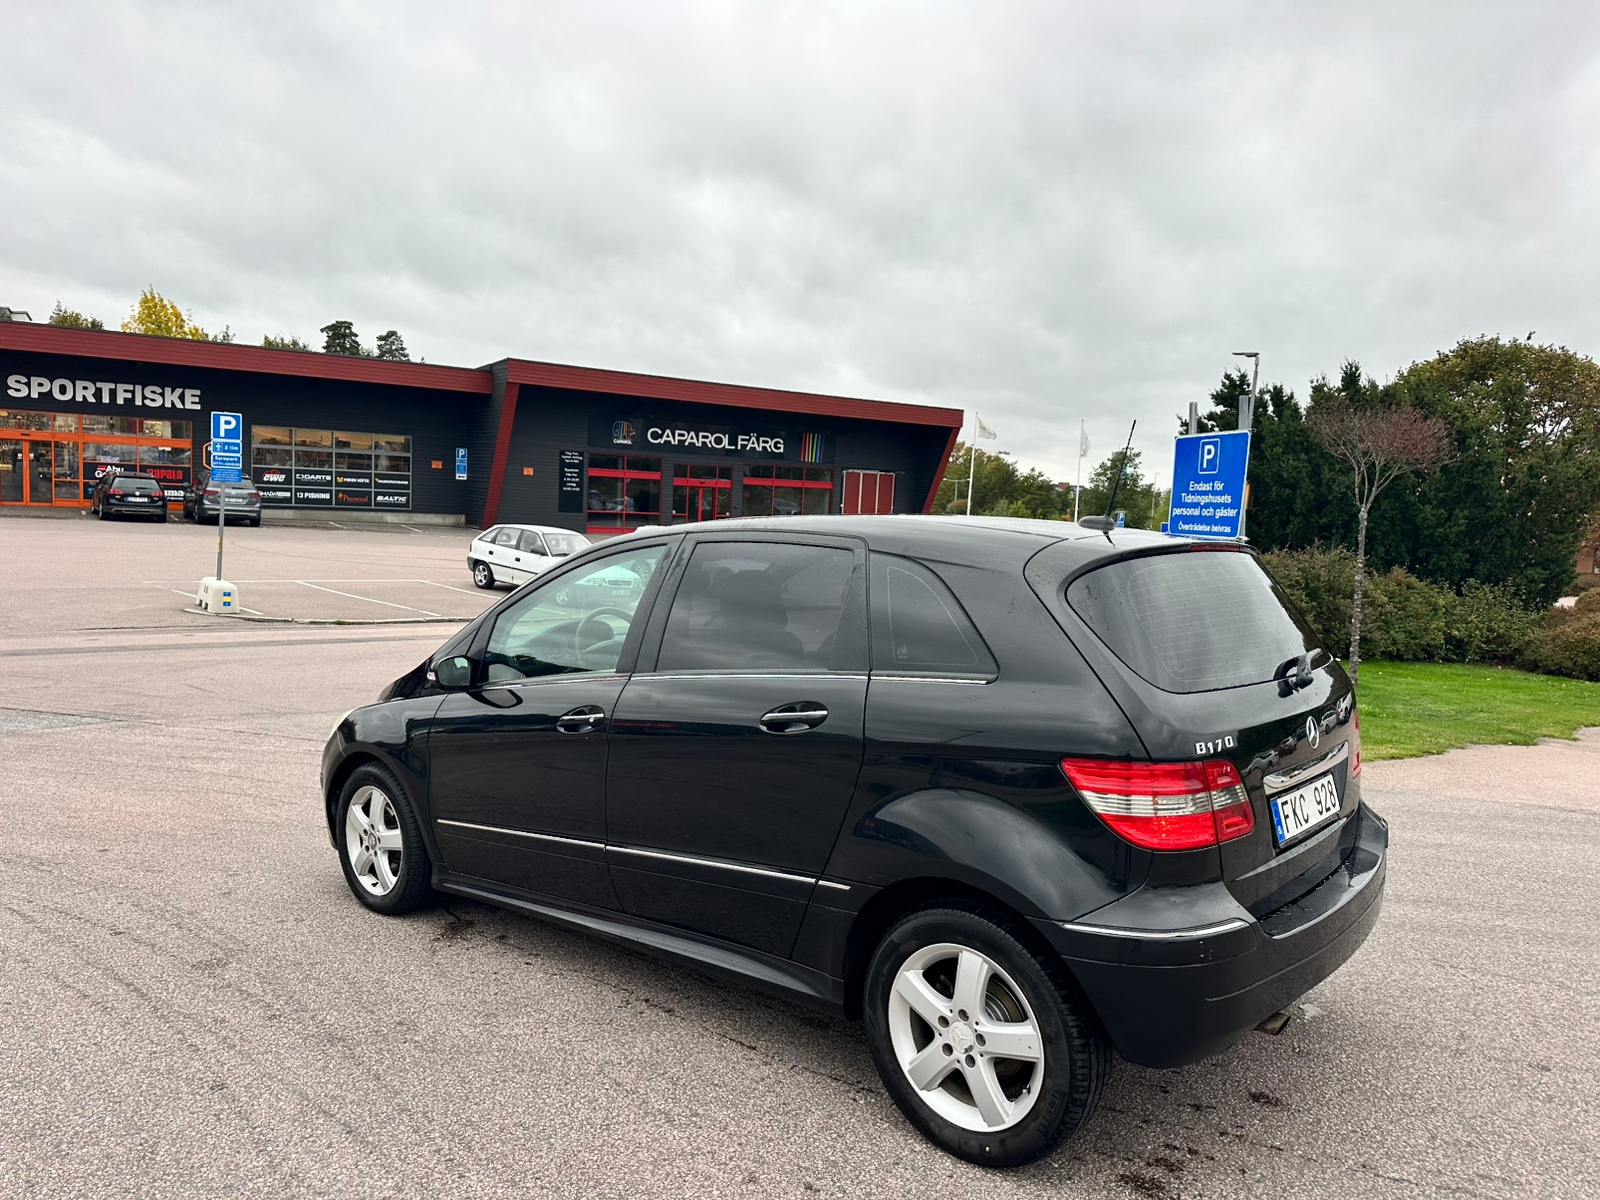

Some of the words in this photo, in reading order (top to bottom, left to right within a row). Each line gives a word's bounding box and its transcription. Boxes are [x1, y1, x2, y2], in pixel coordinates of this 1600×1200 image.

[6, 374, 202, 410] SPORTFISKE
[219, 415, 237, 438] P
[646, 427, 735, 450] CAPAROL
[737, 432, 785, 453] FÄRG
[459, 449, 466, 459] P
[1203, 444, 1215, 469] P
[1189, 481, 1213, 491] Endast
[1213, 481, 1225, 491] för
[296, 491, 304, 499] 13
[304, 492, 330, 500] FISHING
[1181, 493, 1232, 506] Tidningshusets
[1172, 506, 1201, 517] personal
[1201, 507, 1214, 517] och
[1215, 507, 1238, 519] gäster
[1178, 521, 1211, 532] Överträdelse
[1211, 524, 1232, 533] beivras
[1195, 735, 1234, 755] B170
[1280, 793, 1310, 834] FKC
[1313, 779, 1337, 816] 928
